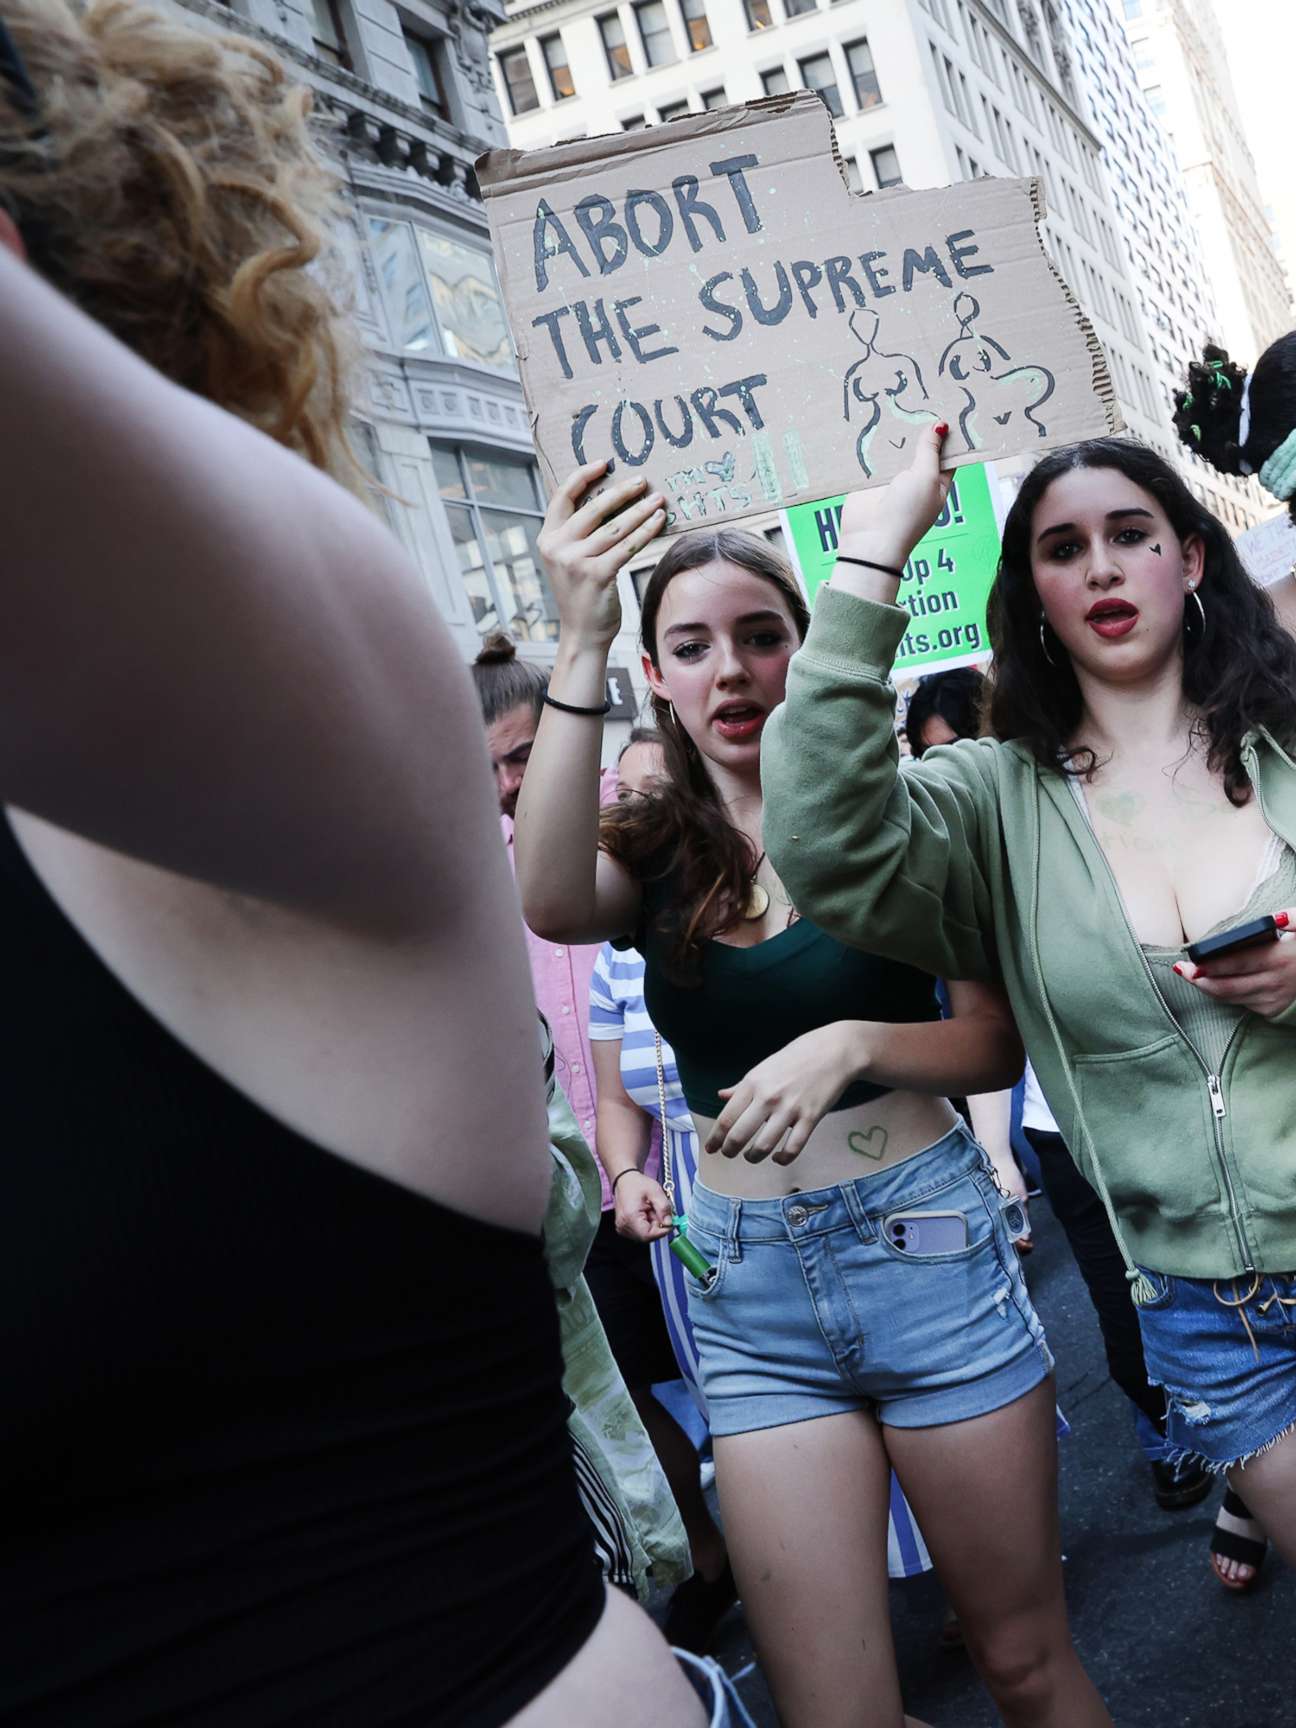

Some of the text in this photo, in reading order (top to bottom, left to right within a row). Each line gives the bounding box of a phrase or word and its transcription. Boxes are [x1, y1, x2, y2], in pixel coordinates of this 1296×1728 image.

[533, 153, 761, 293] ABORT
[532, 229, 994, 379] THE SUPREME
[570, 373, 769, 474] COURT
[938, 548, 954, 573] 4
